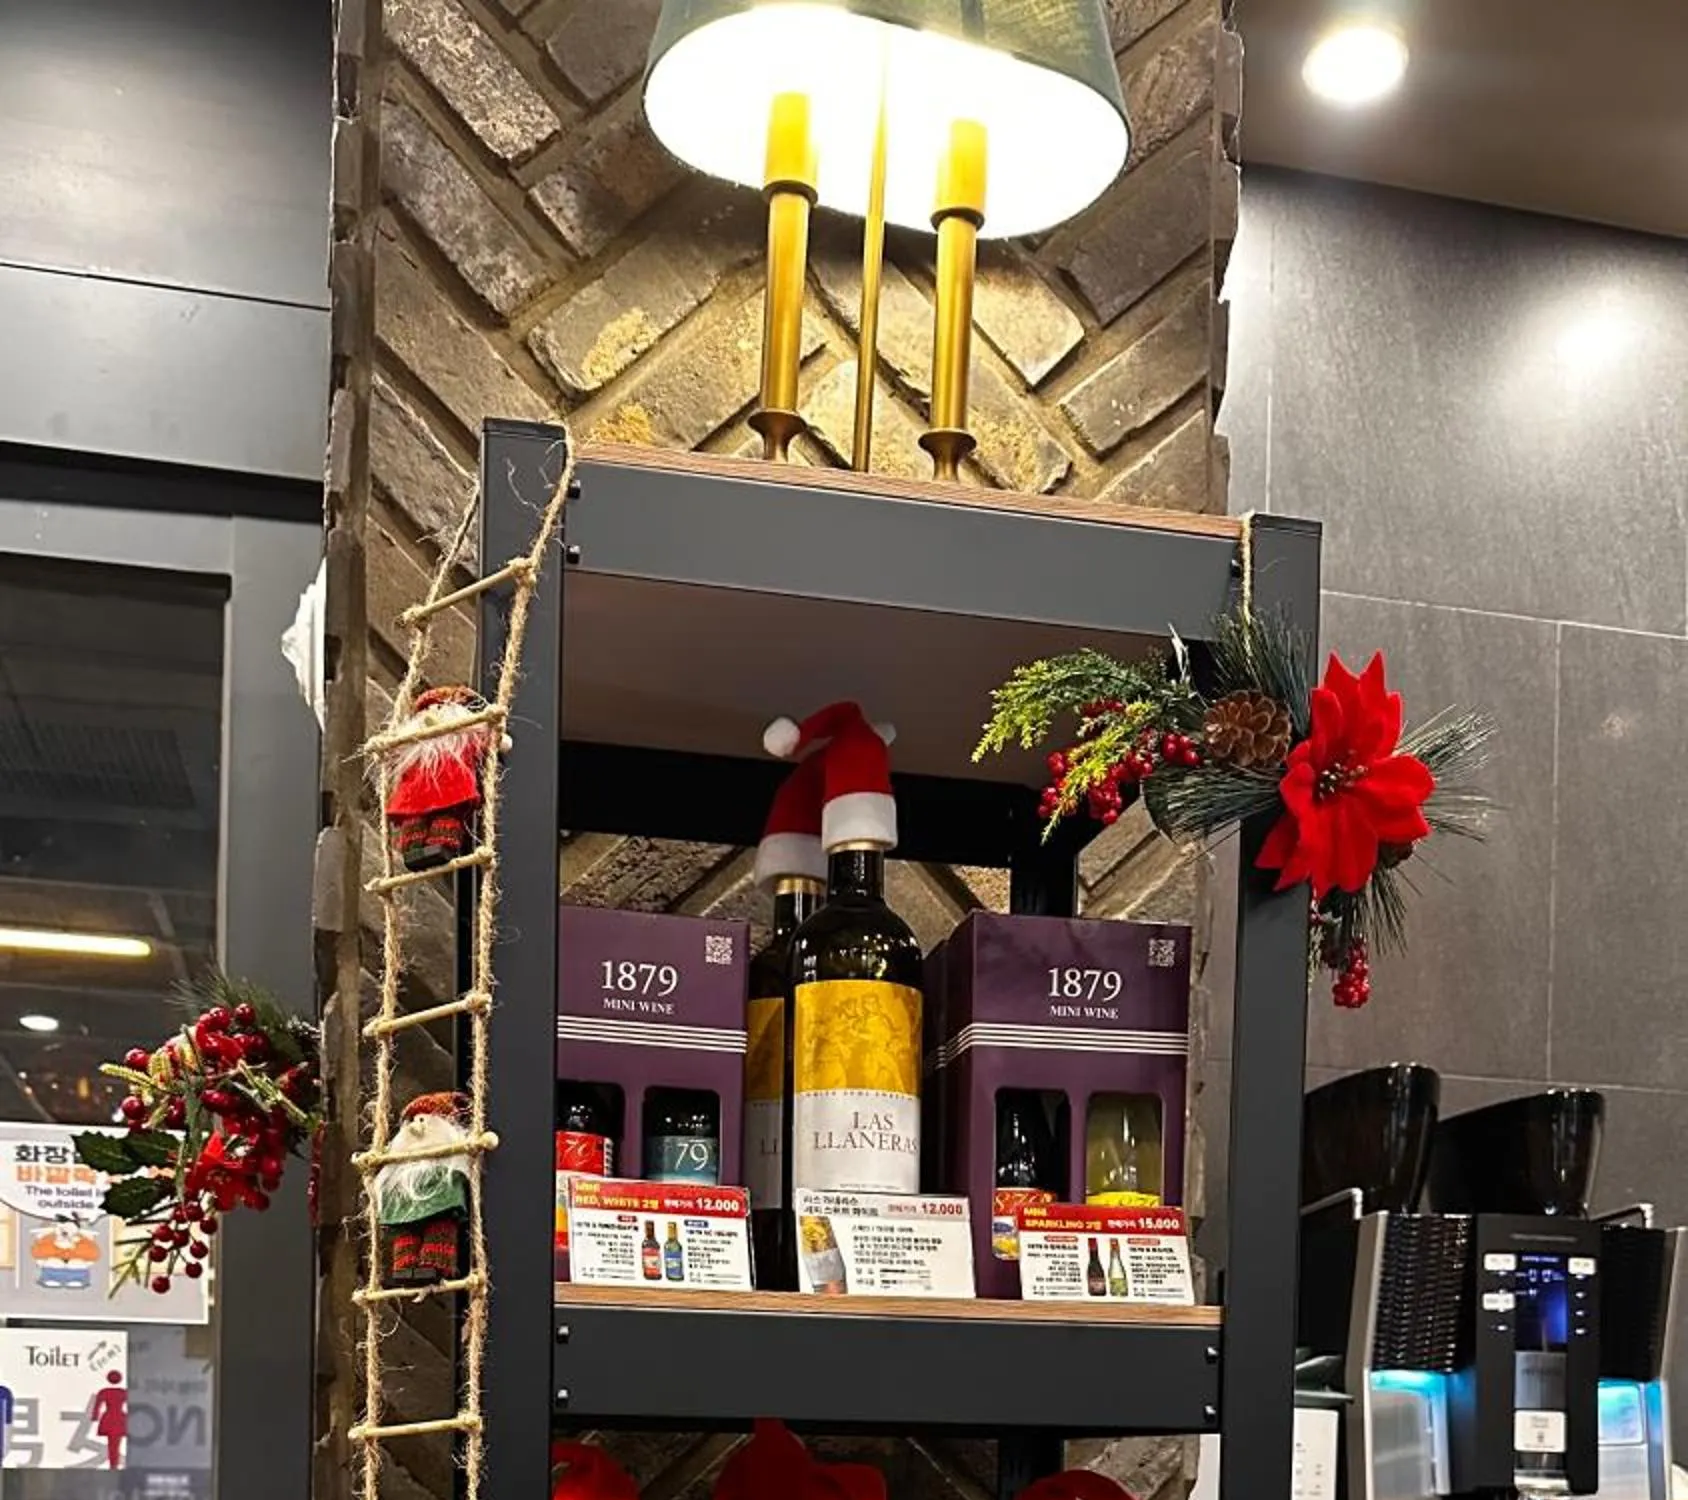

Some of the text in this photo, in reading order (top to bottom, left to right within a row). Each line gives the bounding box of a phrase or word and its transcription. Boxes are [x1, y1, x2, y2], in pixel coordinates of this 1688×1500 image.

[601, 960, 677, 997] 1879
[1048, 967, 1122, 1002] 1879
[603, 998, 675, 1015] MINI WINE
[1051, 1005, 1119, 1019] MINI WINE
[853, 1111, 894, 1131] LAS
[15, 1144, 82, 1164] 화장
[674, 1141, 710, 1171] 79
